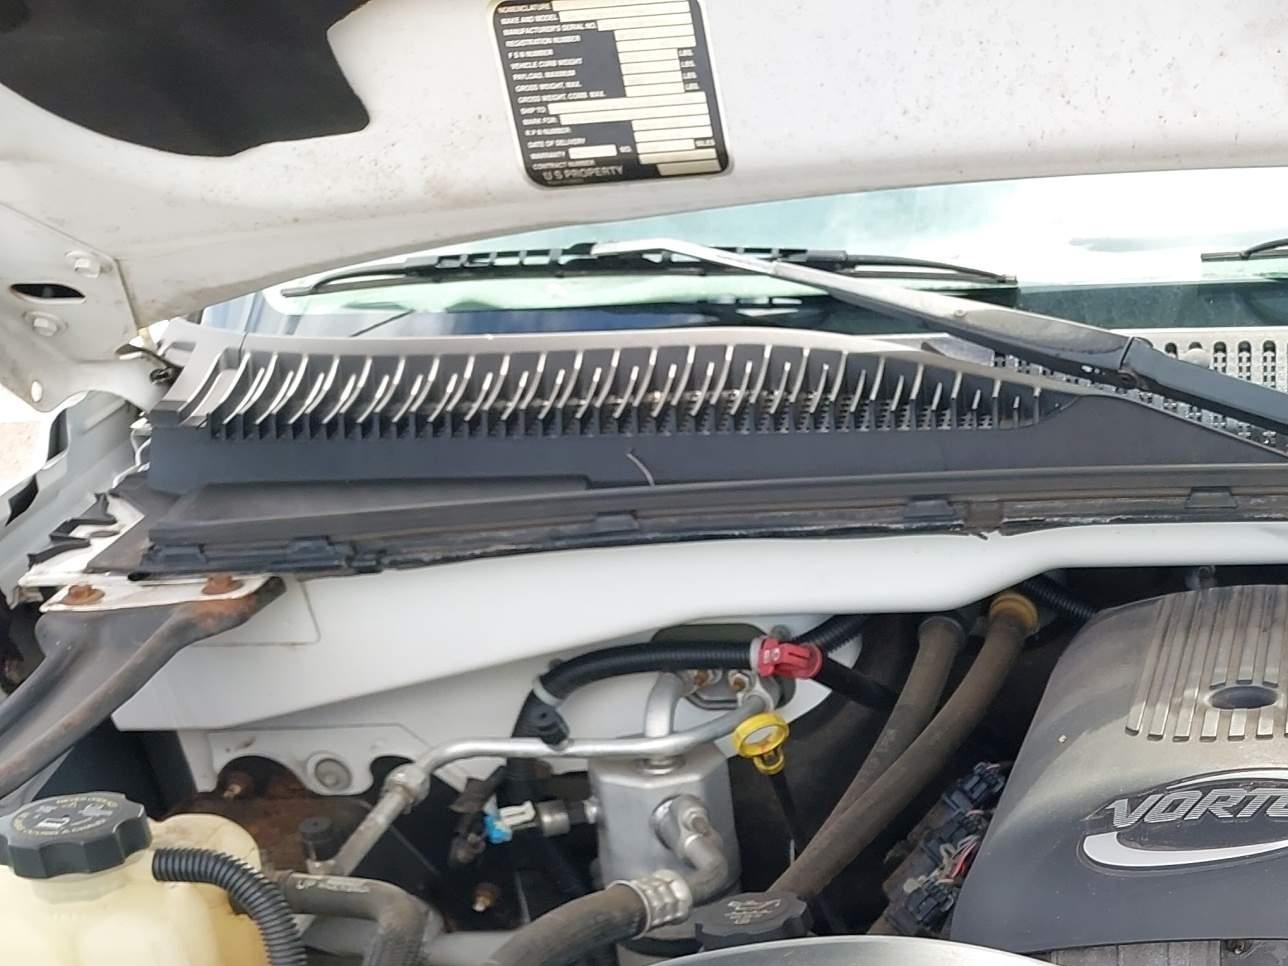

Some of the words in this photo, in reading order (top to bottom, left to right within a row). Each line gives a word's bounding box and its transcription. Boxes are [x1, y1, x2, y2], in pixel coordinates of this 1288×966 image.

[553, 35, 580, 44] NUMBER
[526, 48, 554, 56] NUMBER
[510, 61, 538, 70] VEHICLE
[558, 58, 582, 66] WEIGHT
[515, 84, 538, 92] GROSS
[518, 96, 540, 104] GROSS
[528, 140, 544, 148] DATE
[564, 165, 623, 178] PROPERTY
